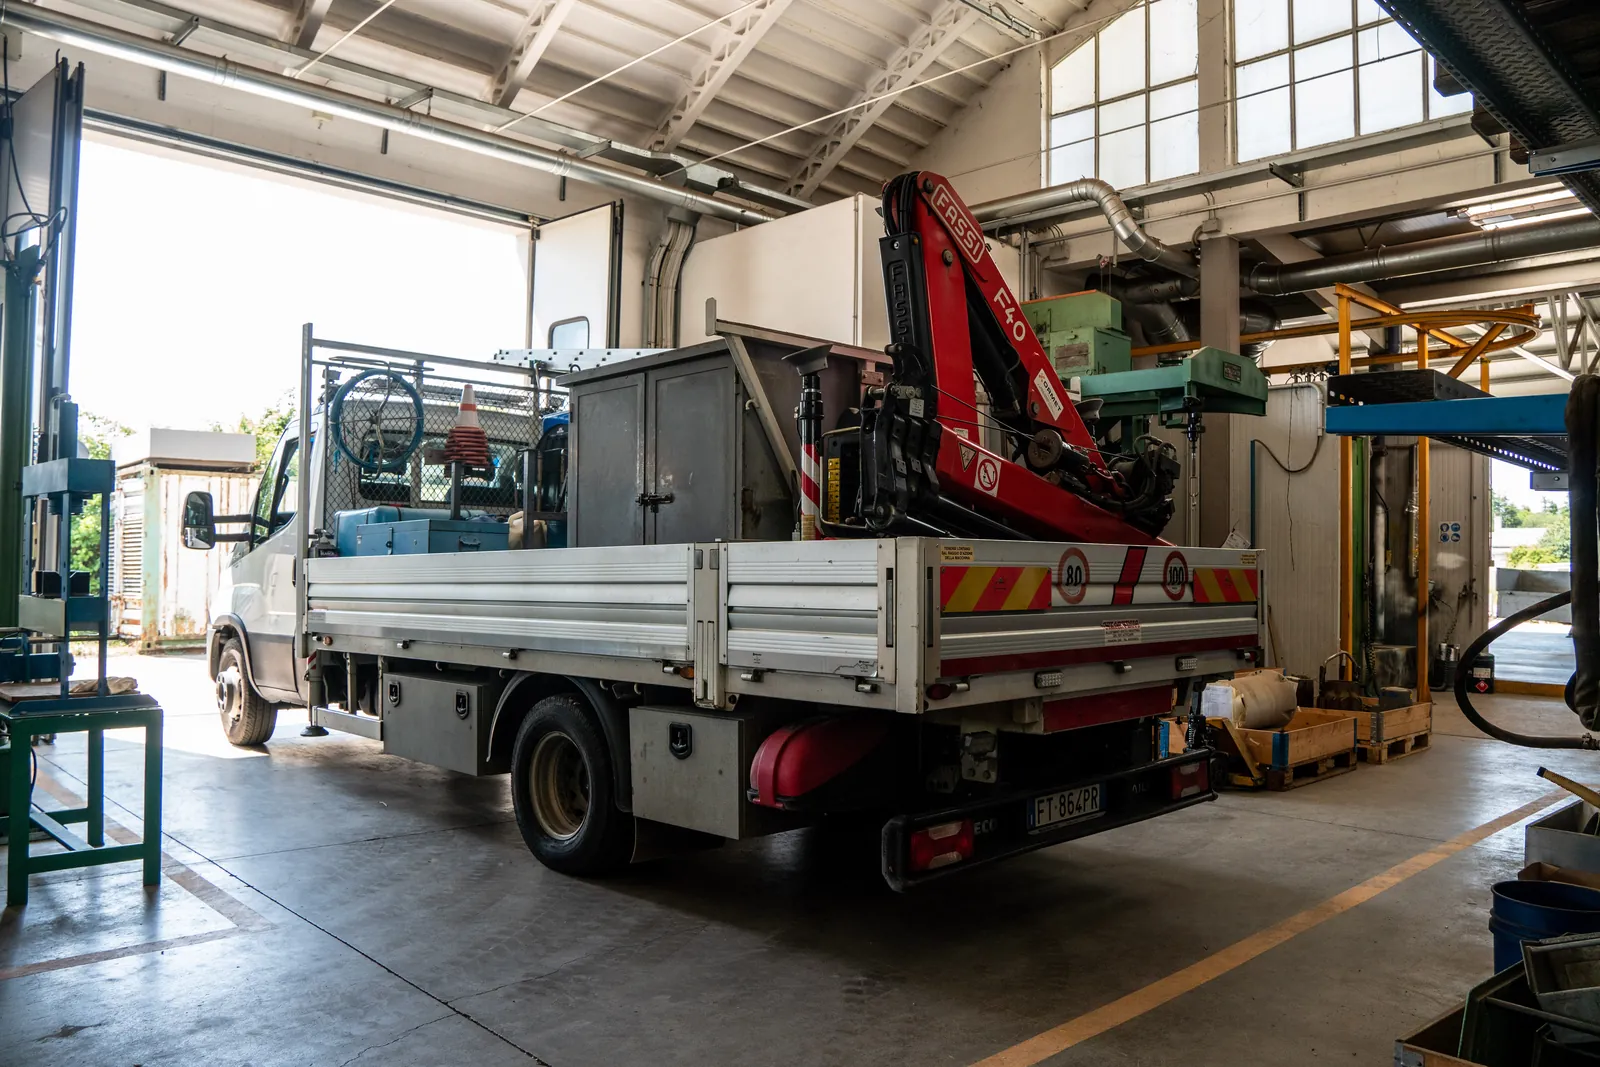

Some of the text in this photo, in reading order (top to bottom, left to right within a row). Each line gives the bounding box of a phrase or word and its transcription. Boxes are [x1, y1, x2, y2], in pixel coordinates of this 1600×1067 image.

[936, 193, 984, 261] FASSI
[993, 287, 1026, 342] F40
[1065, 565, 1083, 587] 80
[1168, 566, 1184, 585] 100
[1037, 786, 1098, 824] FT 864PR
[973, 817, 998, 836] ECO
